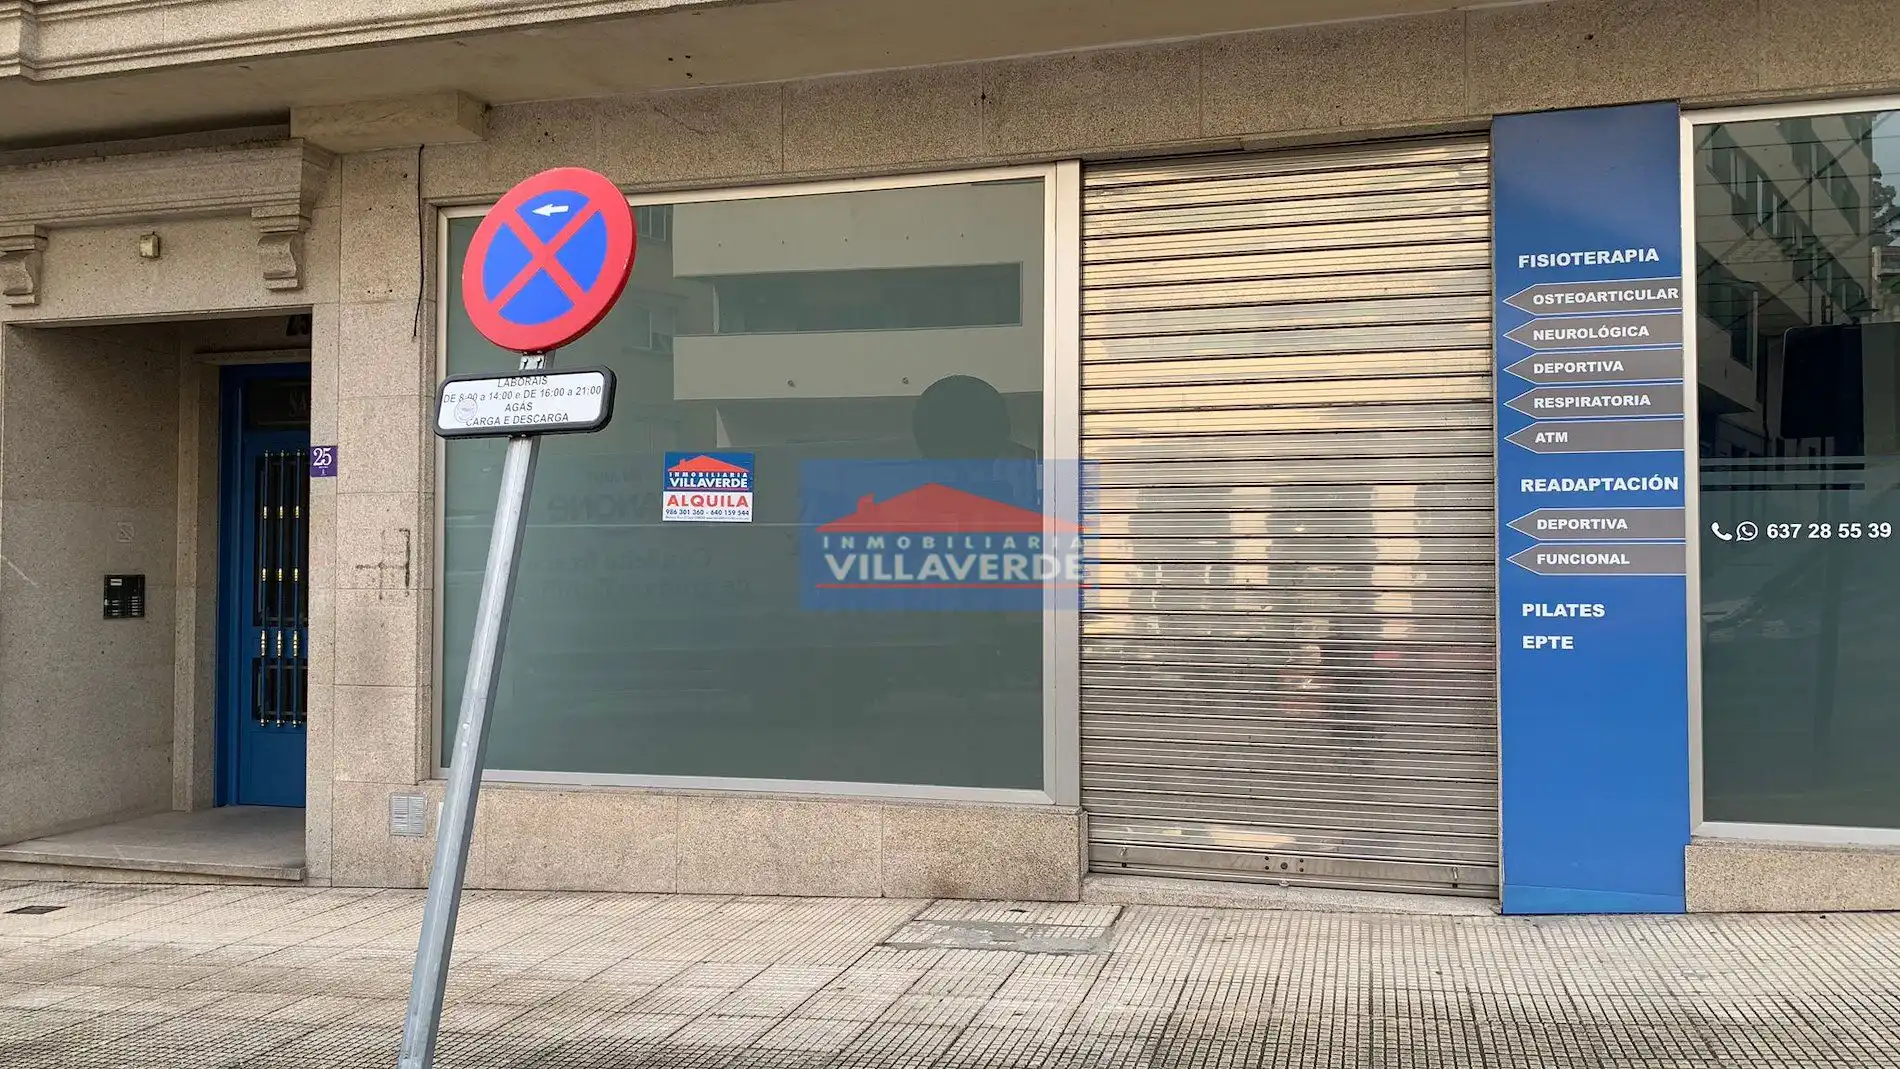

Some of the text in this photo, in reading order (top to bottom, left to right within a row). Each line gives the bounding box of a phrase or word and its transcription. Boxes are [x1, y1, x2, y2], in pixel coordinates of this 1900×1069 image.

[1518, 248, 1659, 268] FISIOTERAPIA
[1532, 287, 1679, 305] OSTEOARTICULAR
[1533, 325, 1649, 341] NEUROLÓGICA
[1533, 361, 1624, 374] DEPORTIVA
[498, 376, 548, 388] LABORAIS
[444, 394, 456, 403] DE
[489, 391, 512, 400] 14:00
[524, 389, 536, 398] DE
[541, 387, 564, 397] 16:00
[576, 386, 601, 395] 21:00
[505, 402, 533, 412] AGÁS
[1533, 395, 1651, 409] RESPIRATORIA
[466, 413, 569, 426] CARGA E DESCARGA
[1535, 432, 1568, 444] ATM
[313, 448, 332, 466] 25
[670, 478, 747, 487] VILLAVERDE
[1521, 474, 1678, 492] READAPTACIÓN
[667, 495, 748, 507] ALQUILA
[1537, 519, 1628, 530] DEPORTIVA
[1767, 523, 1892, 539] 637 28 55 39
[1537, 553, 1630, 565] FUNCIONAL
[1522, 603, 1605, 617] PILATES
[1522, 636, 1573, 650] EPTE
